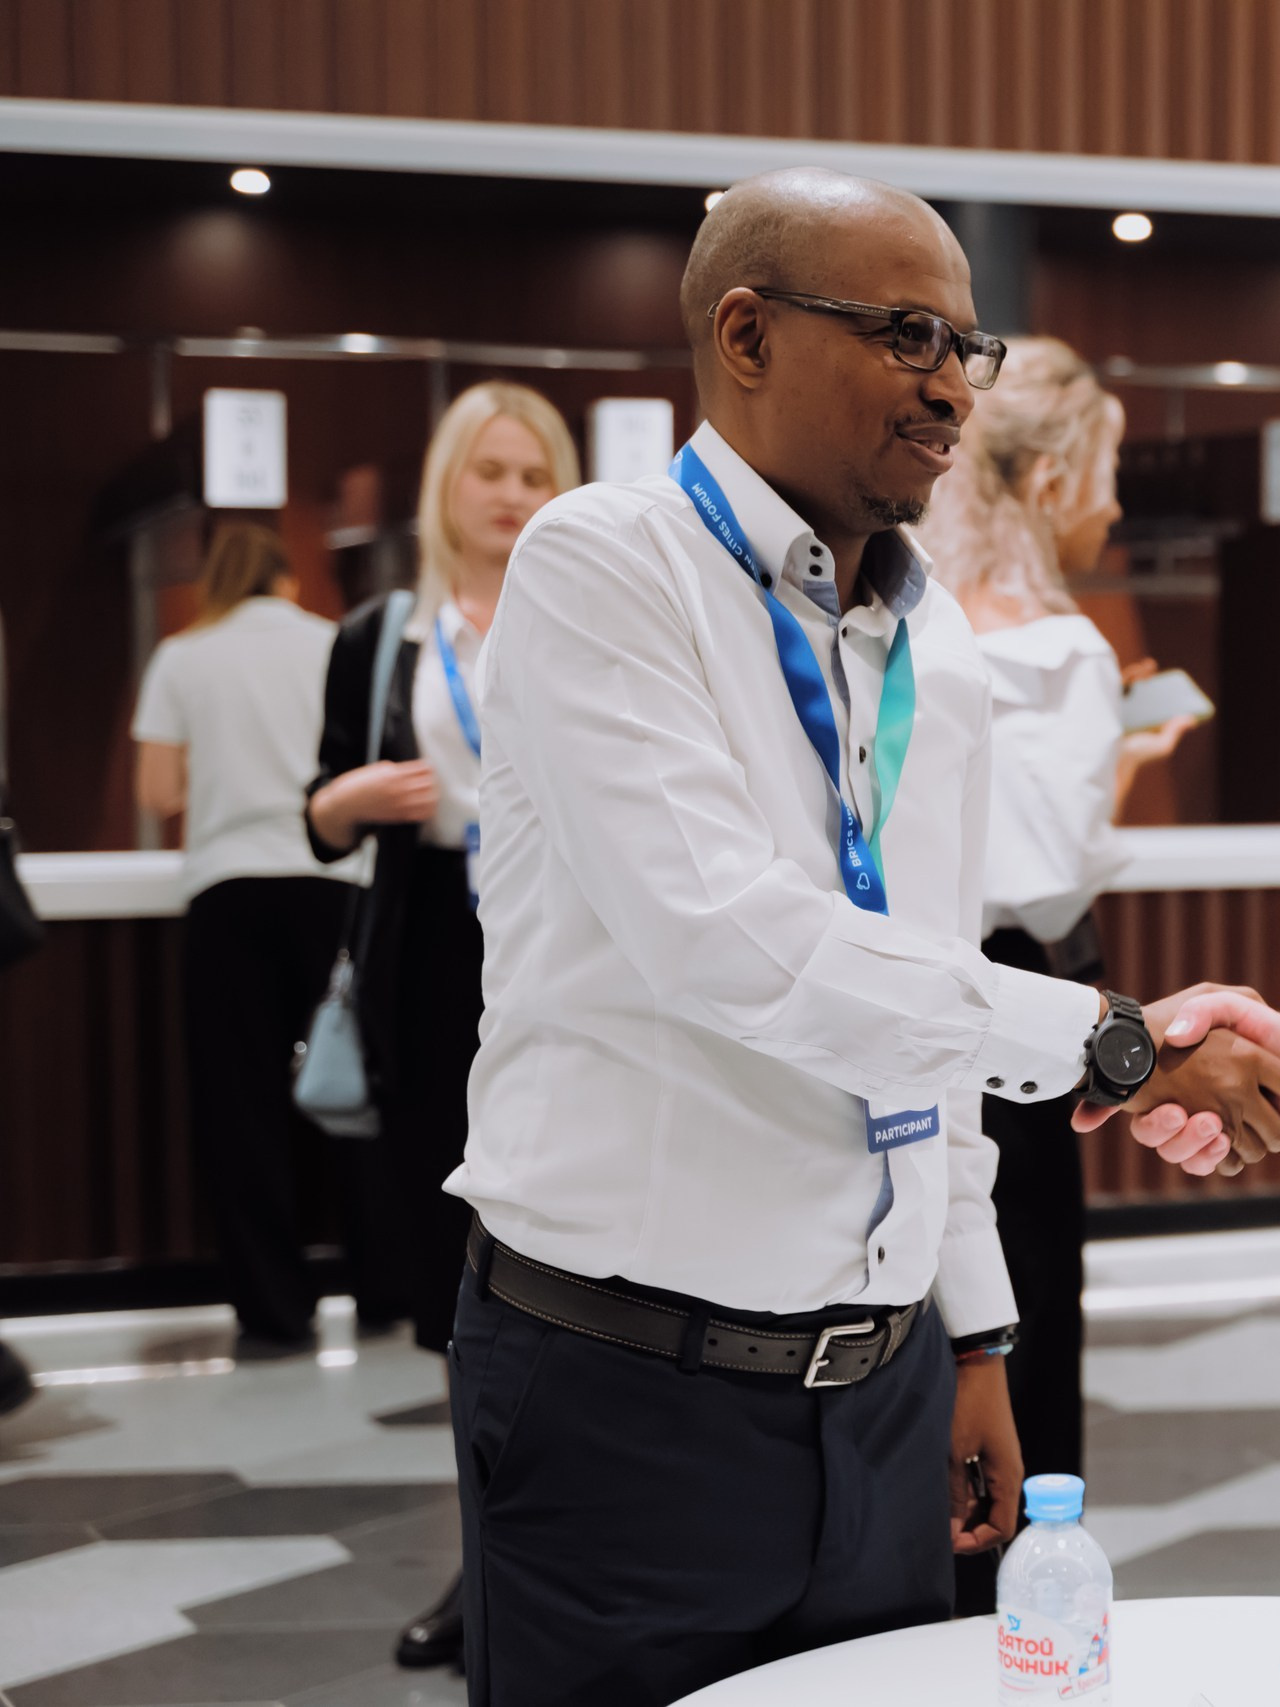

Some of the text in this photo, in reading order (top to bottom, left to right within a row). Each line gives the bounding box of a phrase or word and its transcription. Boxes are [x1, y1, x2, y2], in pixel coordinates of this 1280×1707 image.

[691, 483, 743, 555] CITIES FORUM
[846, 829, 862, 868] BRICS
[875, 1116, 932, 1144] PARTICIPANT
